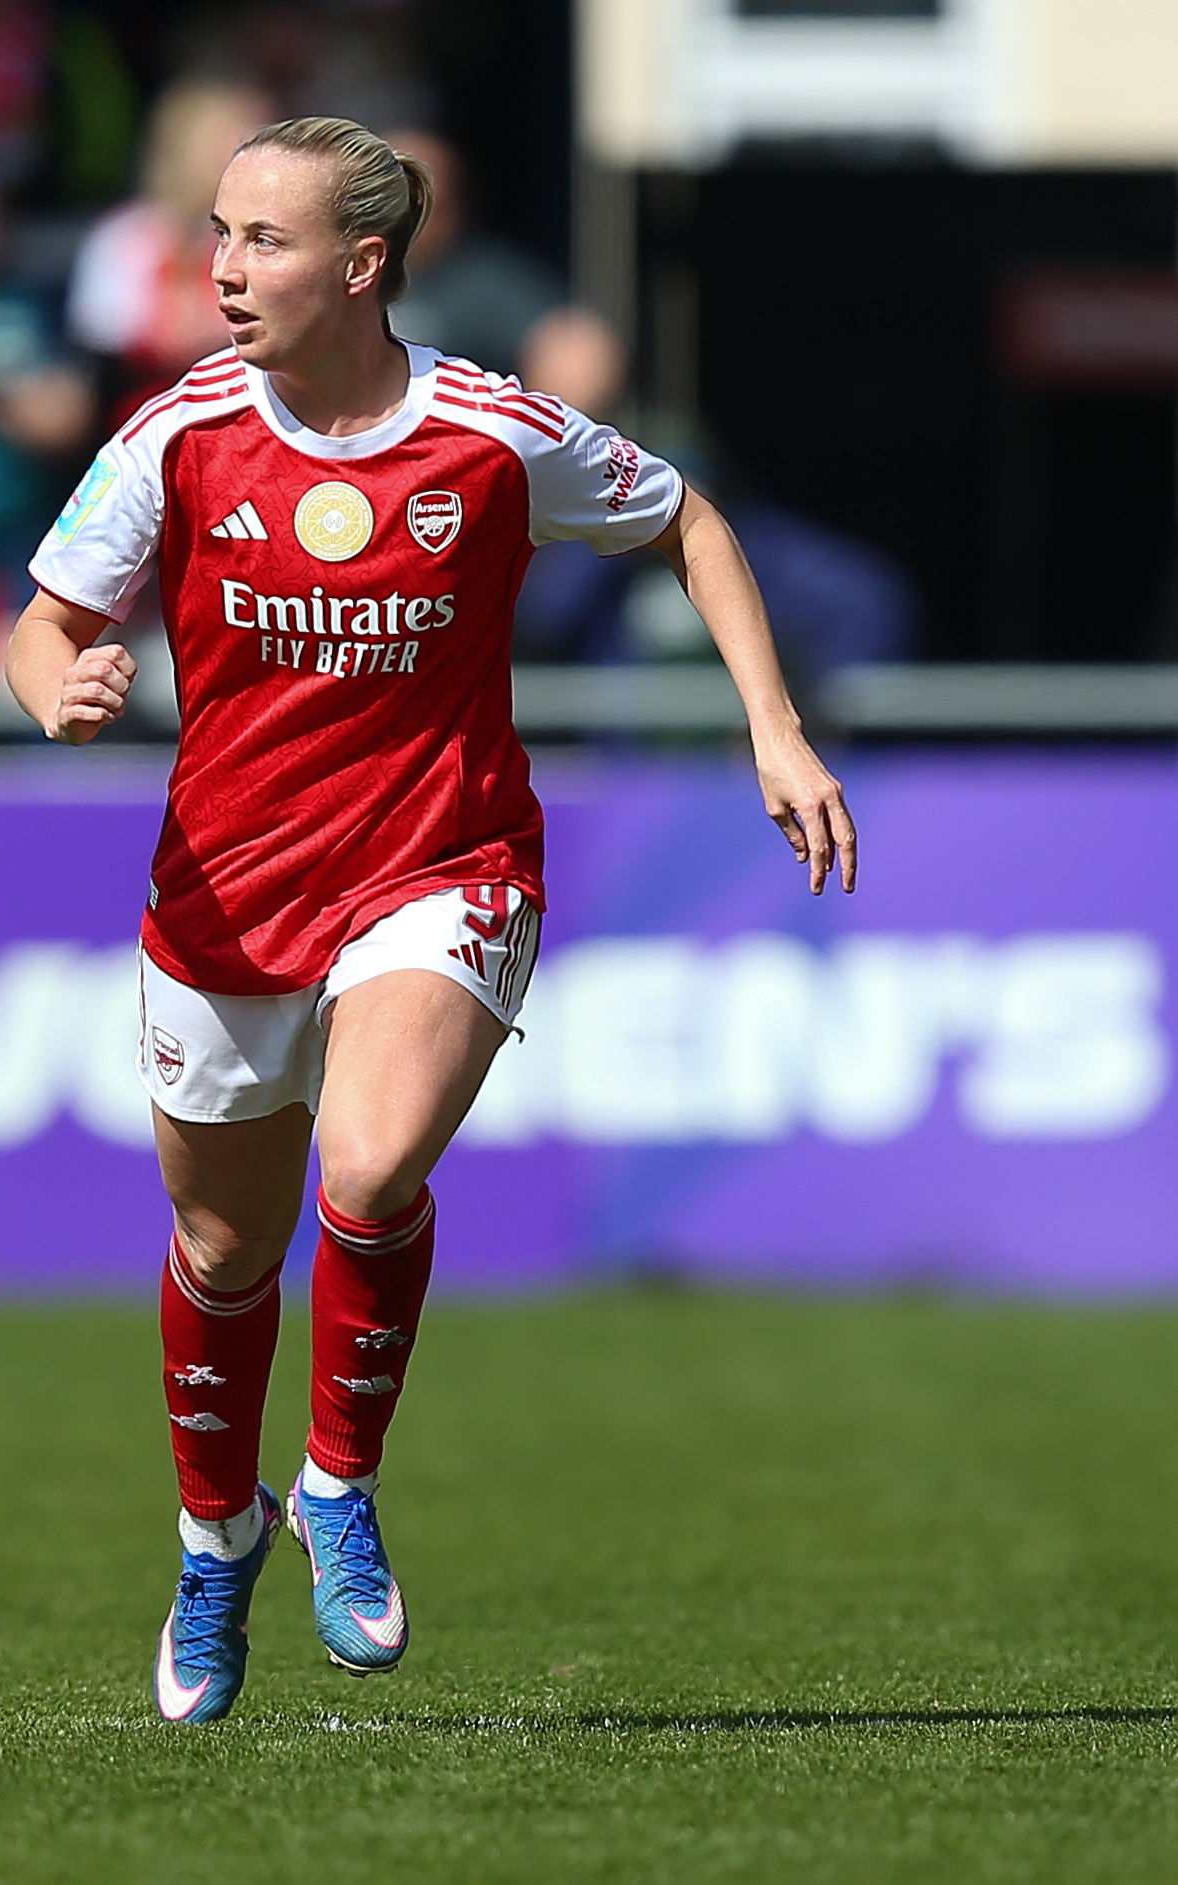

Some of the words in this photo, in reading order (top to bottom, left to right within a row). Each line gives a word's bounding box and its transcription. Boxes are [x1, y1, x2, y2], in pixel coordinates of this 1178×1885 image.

[603, 436, 624, 480] VISIT
[415, 501, 454, 514] Arsenal
[221, 578, 455, 636] Emirates
[261, 635, 306, 669] FLY
[315, 640, 420, 679] BETTER
[460, 884, 509, 942] 9
